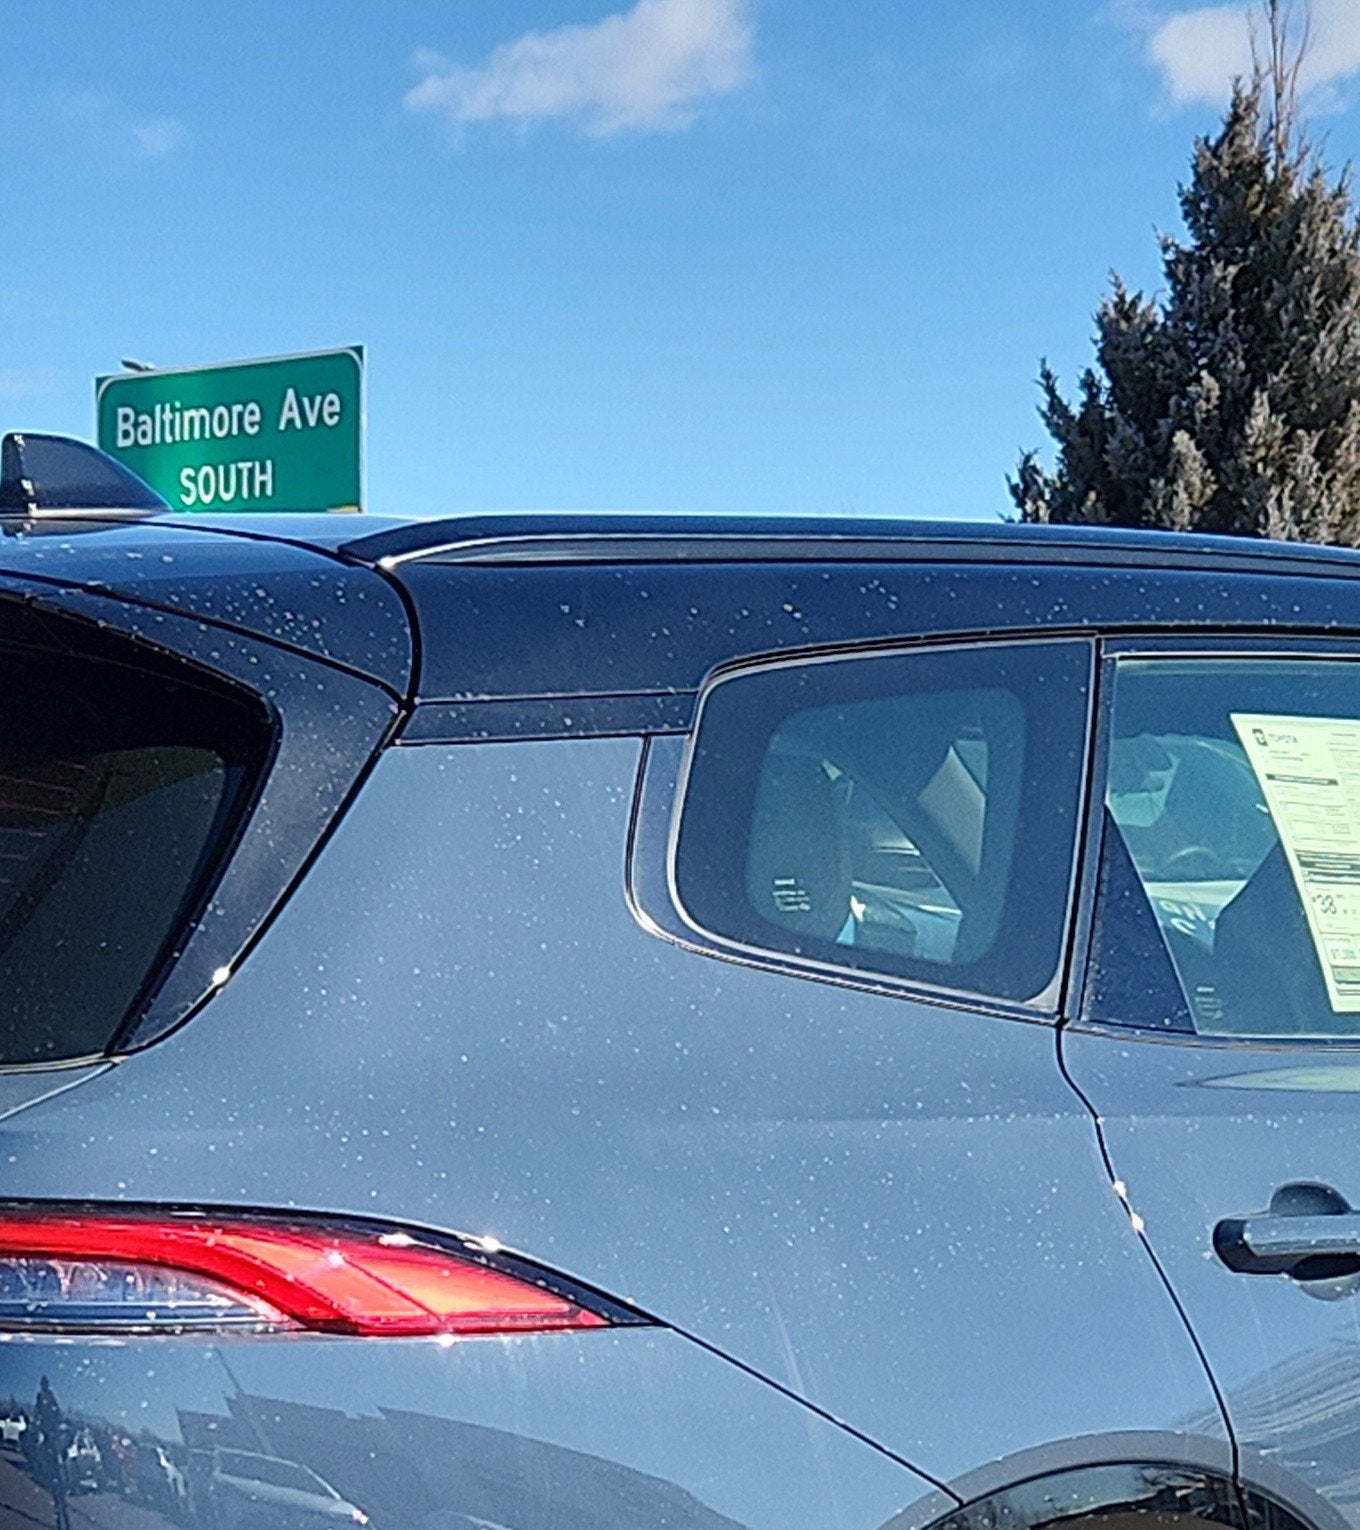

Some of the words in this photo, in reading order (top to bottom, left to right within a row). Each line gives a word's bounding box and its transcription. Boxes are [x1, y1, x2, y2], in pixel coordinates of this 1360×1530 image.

[116, 401, 261, 448] Baltimore
[278, 388, 341, 431] Ave
[179, 460, 274, 506] SOUTH
